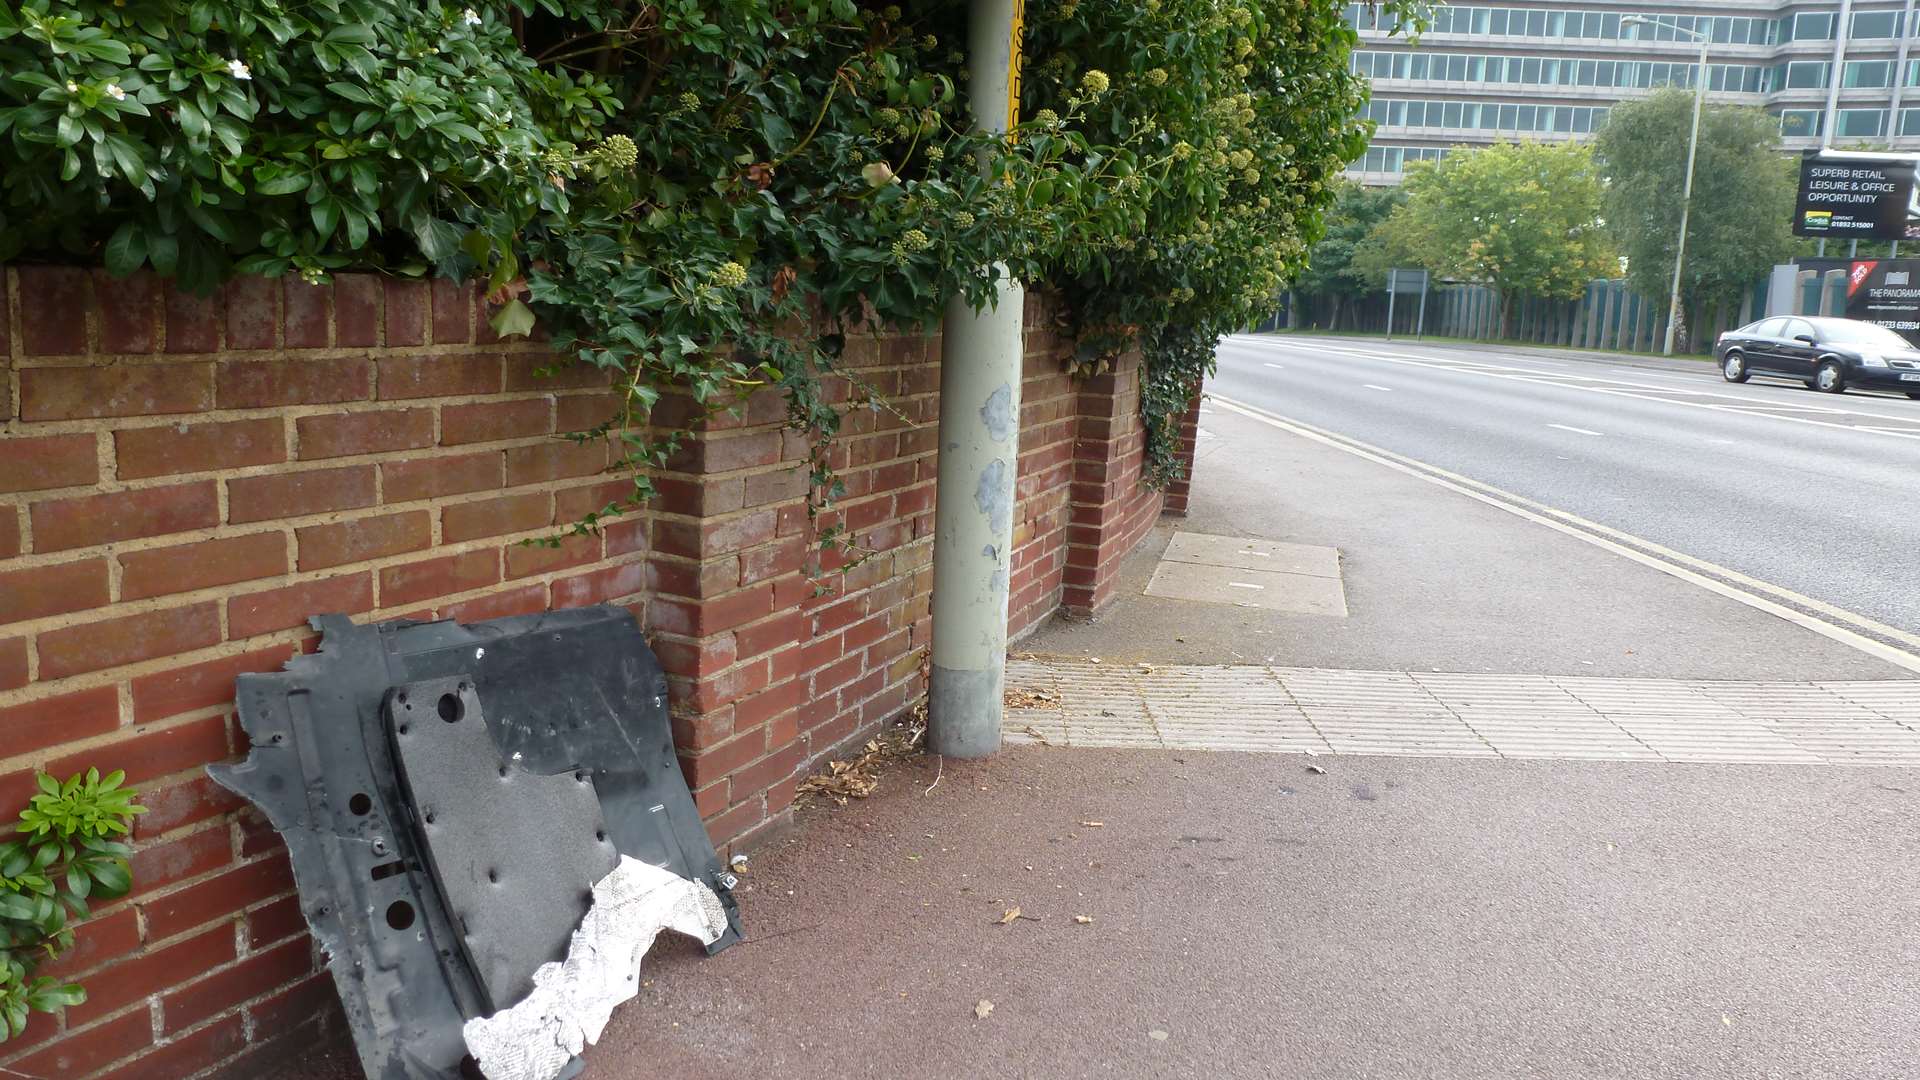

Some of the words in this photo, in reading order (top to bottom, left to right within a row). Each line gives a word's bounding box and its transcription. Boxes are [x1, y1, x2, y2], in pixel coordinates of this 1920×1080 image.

[1811, 168, 1850, 178] SUPERB
[1809, 180, 1849, 190] LEISURE
[1851, 182, 1859, 191] &
[1861, 182, 1896, 192] OFFICE
[1808, 192, 1878, 203] OPPORTUNITY
[1870, 288, 1883, 298] THE
